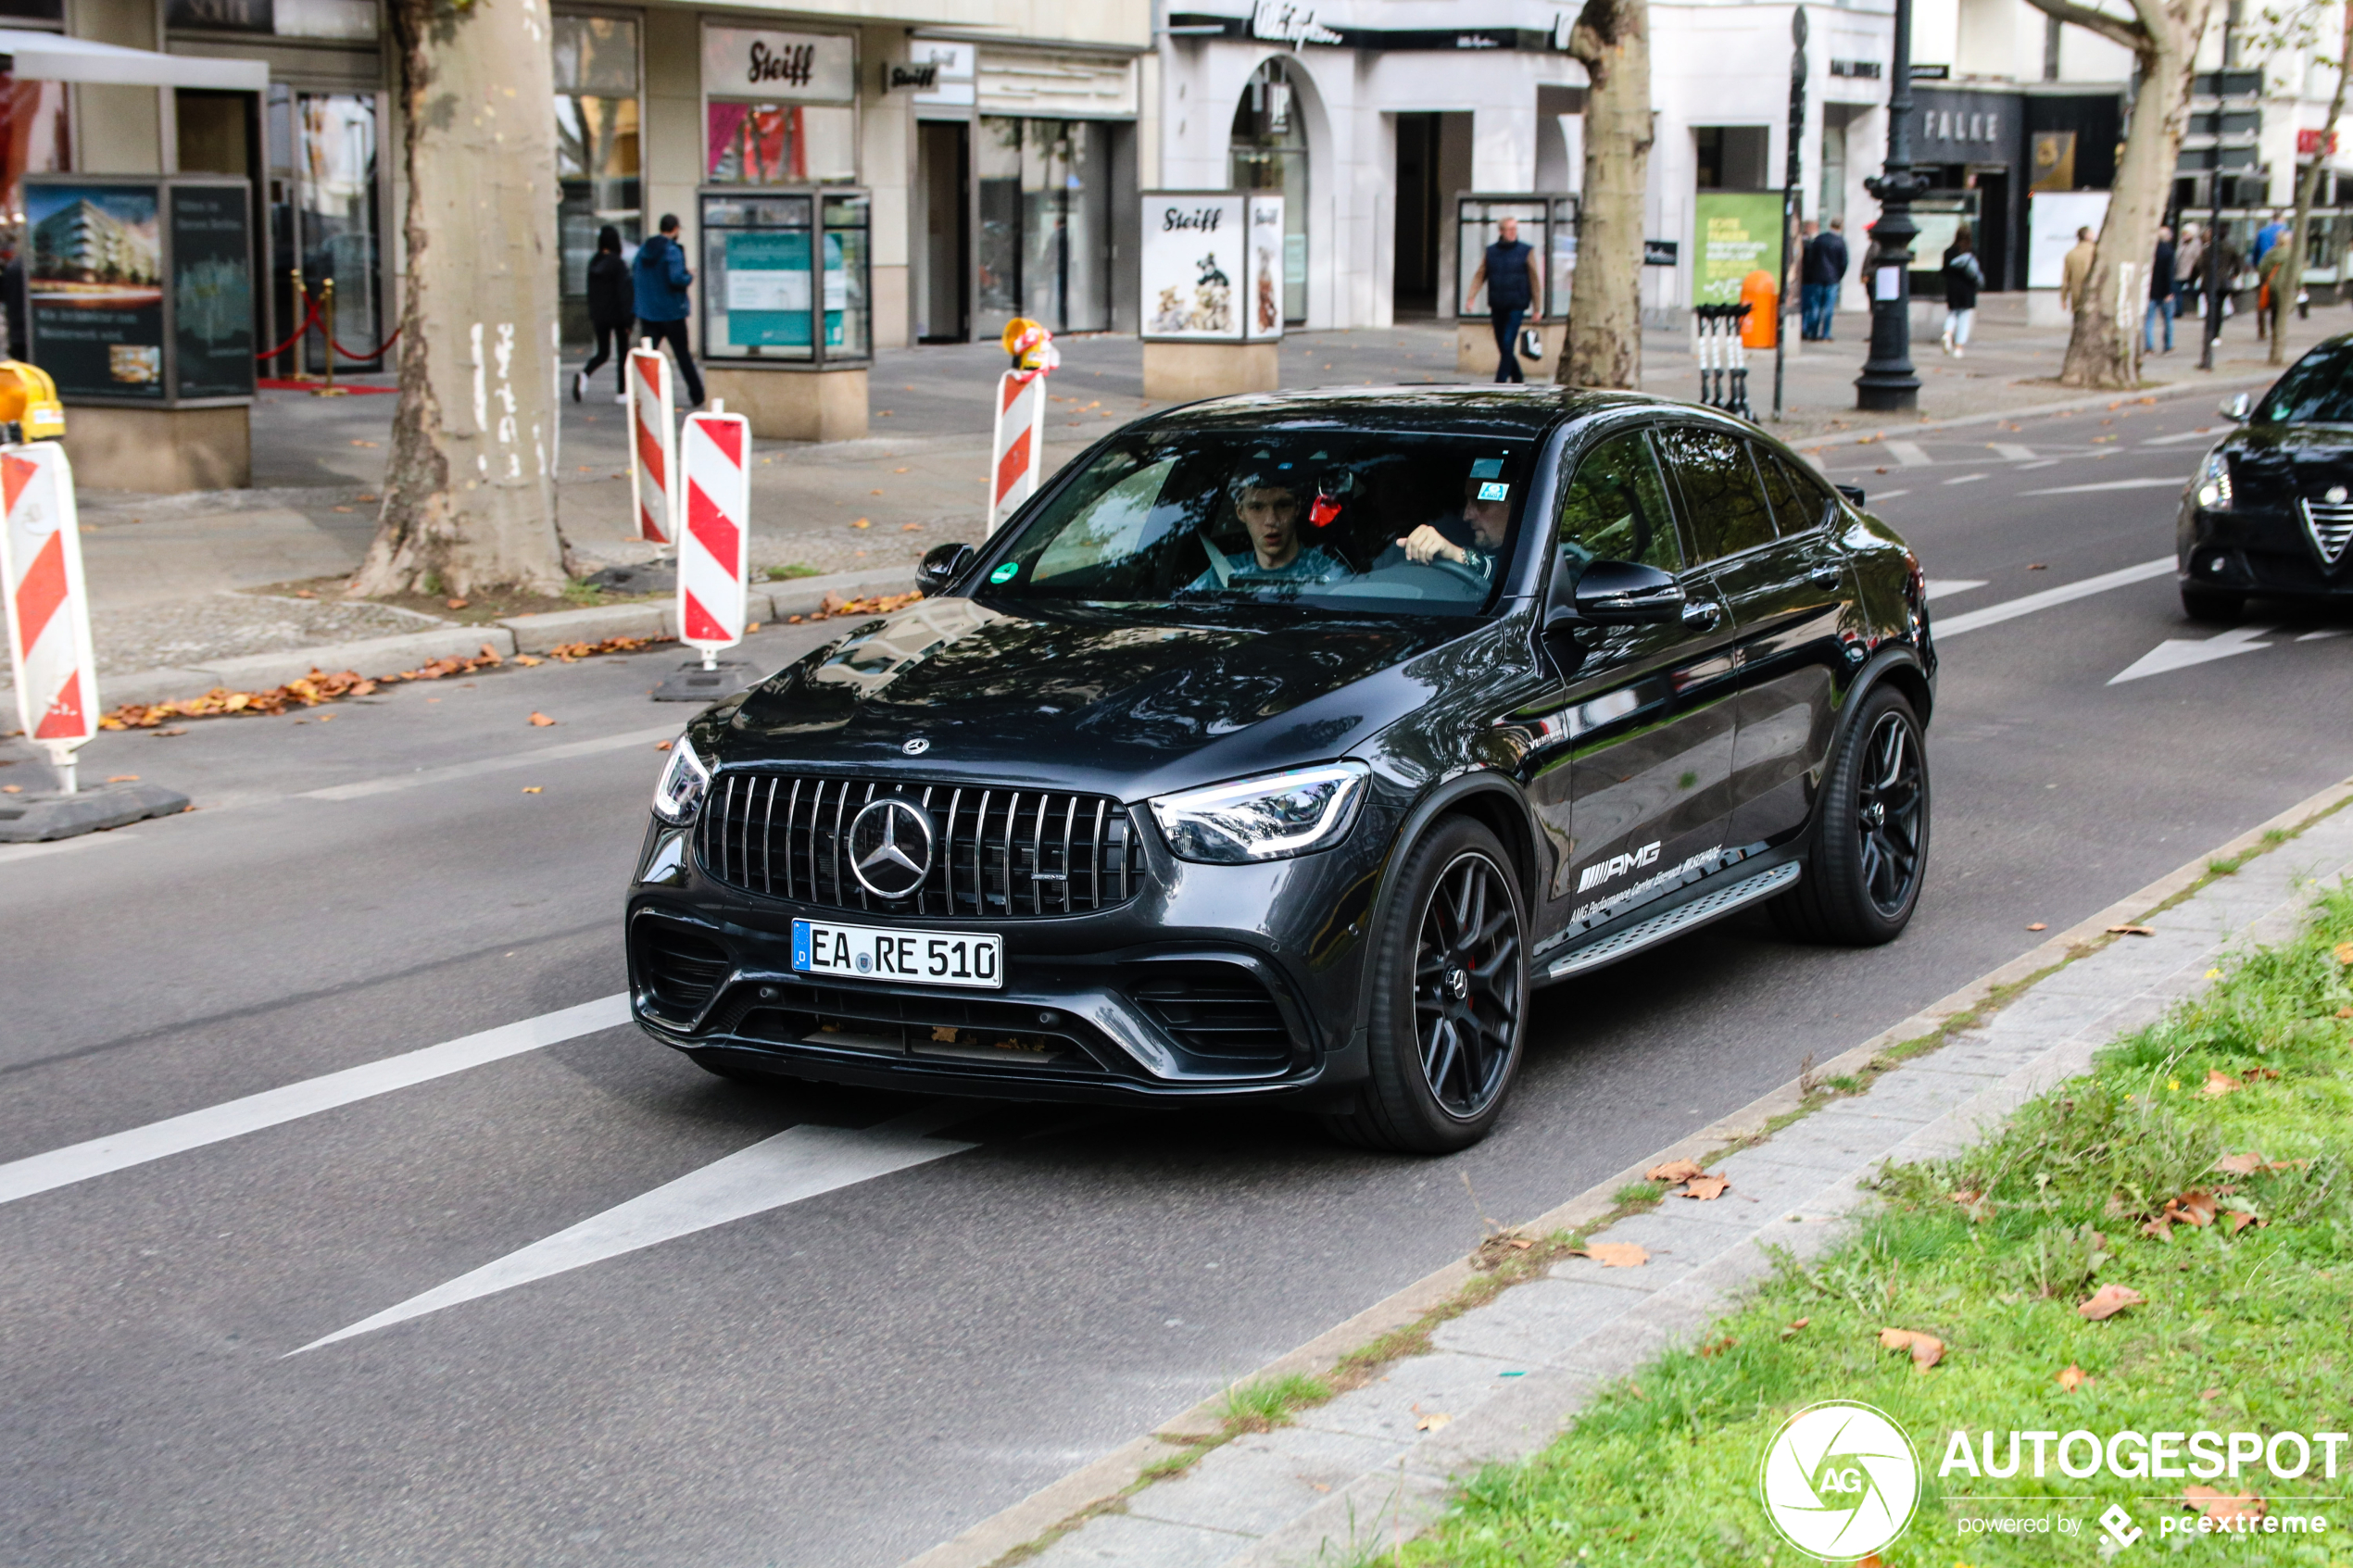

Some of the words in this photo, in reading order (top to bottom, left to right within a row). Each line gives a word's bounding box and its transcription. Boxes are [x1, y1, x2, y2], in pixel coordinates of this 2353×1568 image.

[749, 41, 814, 87] Steiff
[891, 66, 937, 88] Steiff
[1924, 109, 1998, 142] FALKE
[1163, 207, 1222, 232] Steiff
[1600, 840, 1661, 885] AMG
[1569, 904, 1589, 925] AMG
[1587, 887, 1631, 917] Performance
[1631, 876, 1655, 897] Center
[799, 950, 806, 962] D
[812, 929, 851, 969] EA
[876, 935, 919, 974] RE
[928, 939, 996, 979] 510
